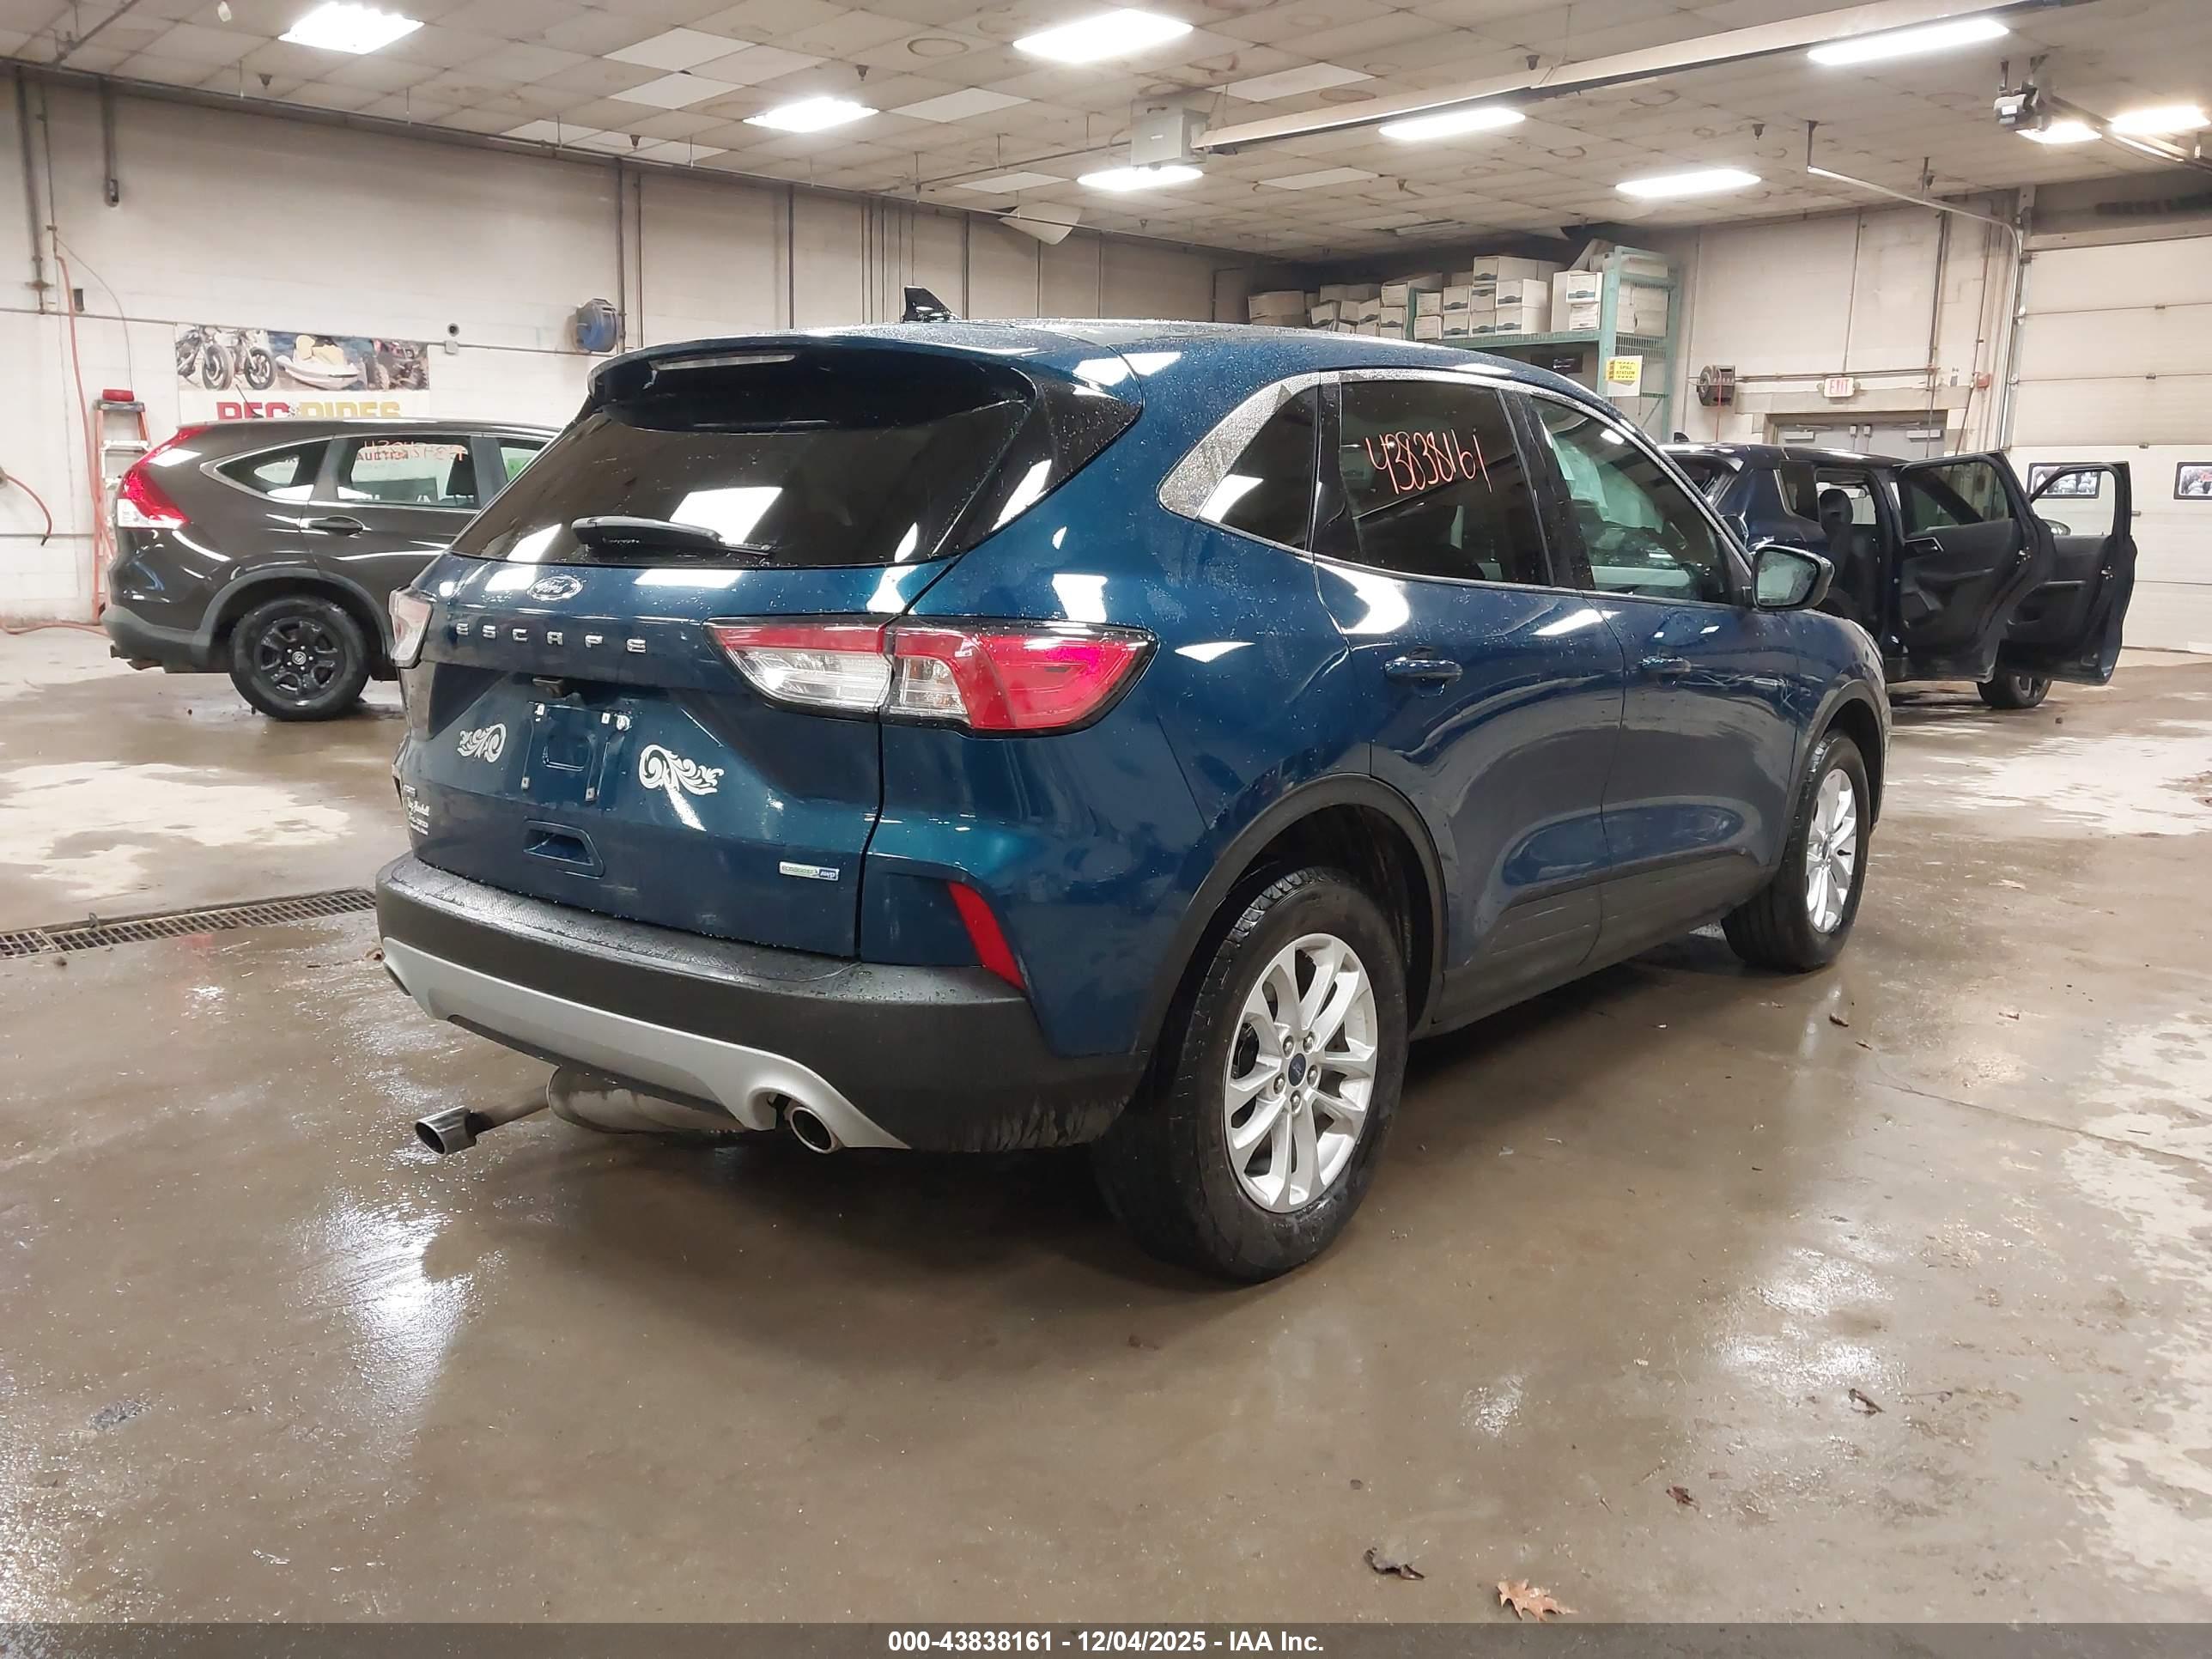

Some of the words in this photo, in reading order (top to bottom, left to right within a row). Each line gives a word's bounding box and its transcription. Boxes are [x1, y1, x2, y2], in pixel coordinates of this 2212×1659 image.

[1830, 379, 1850, 395] EXIT
[1365, 428, 1492, 495] 43838161
[456, 623, 647, 653] ESCAPE
